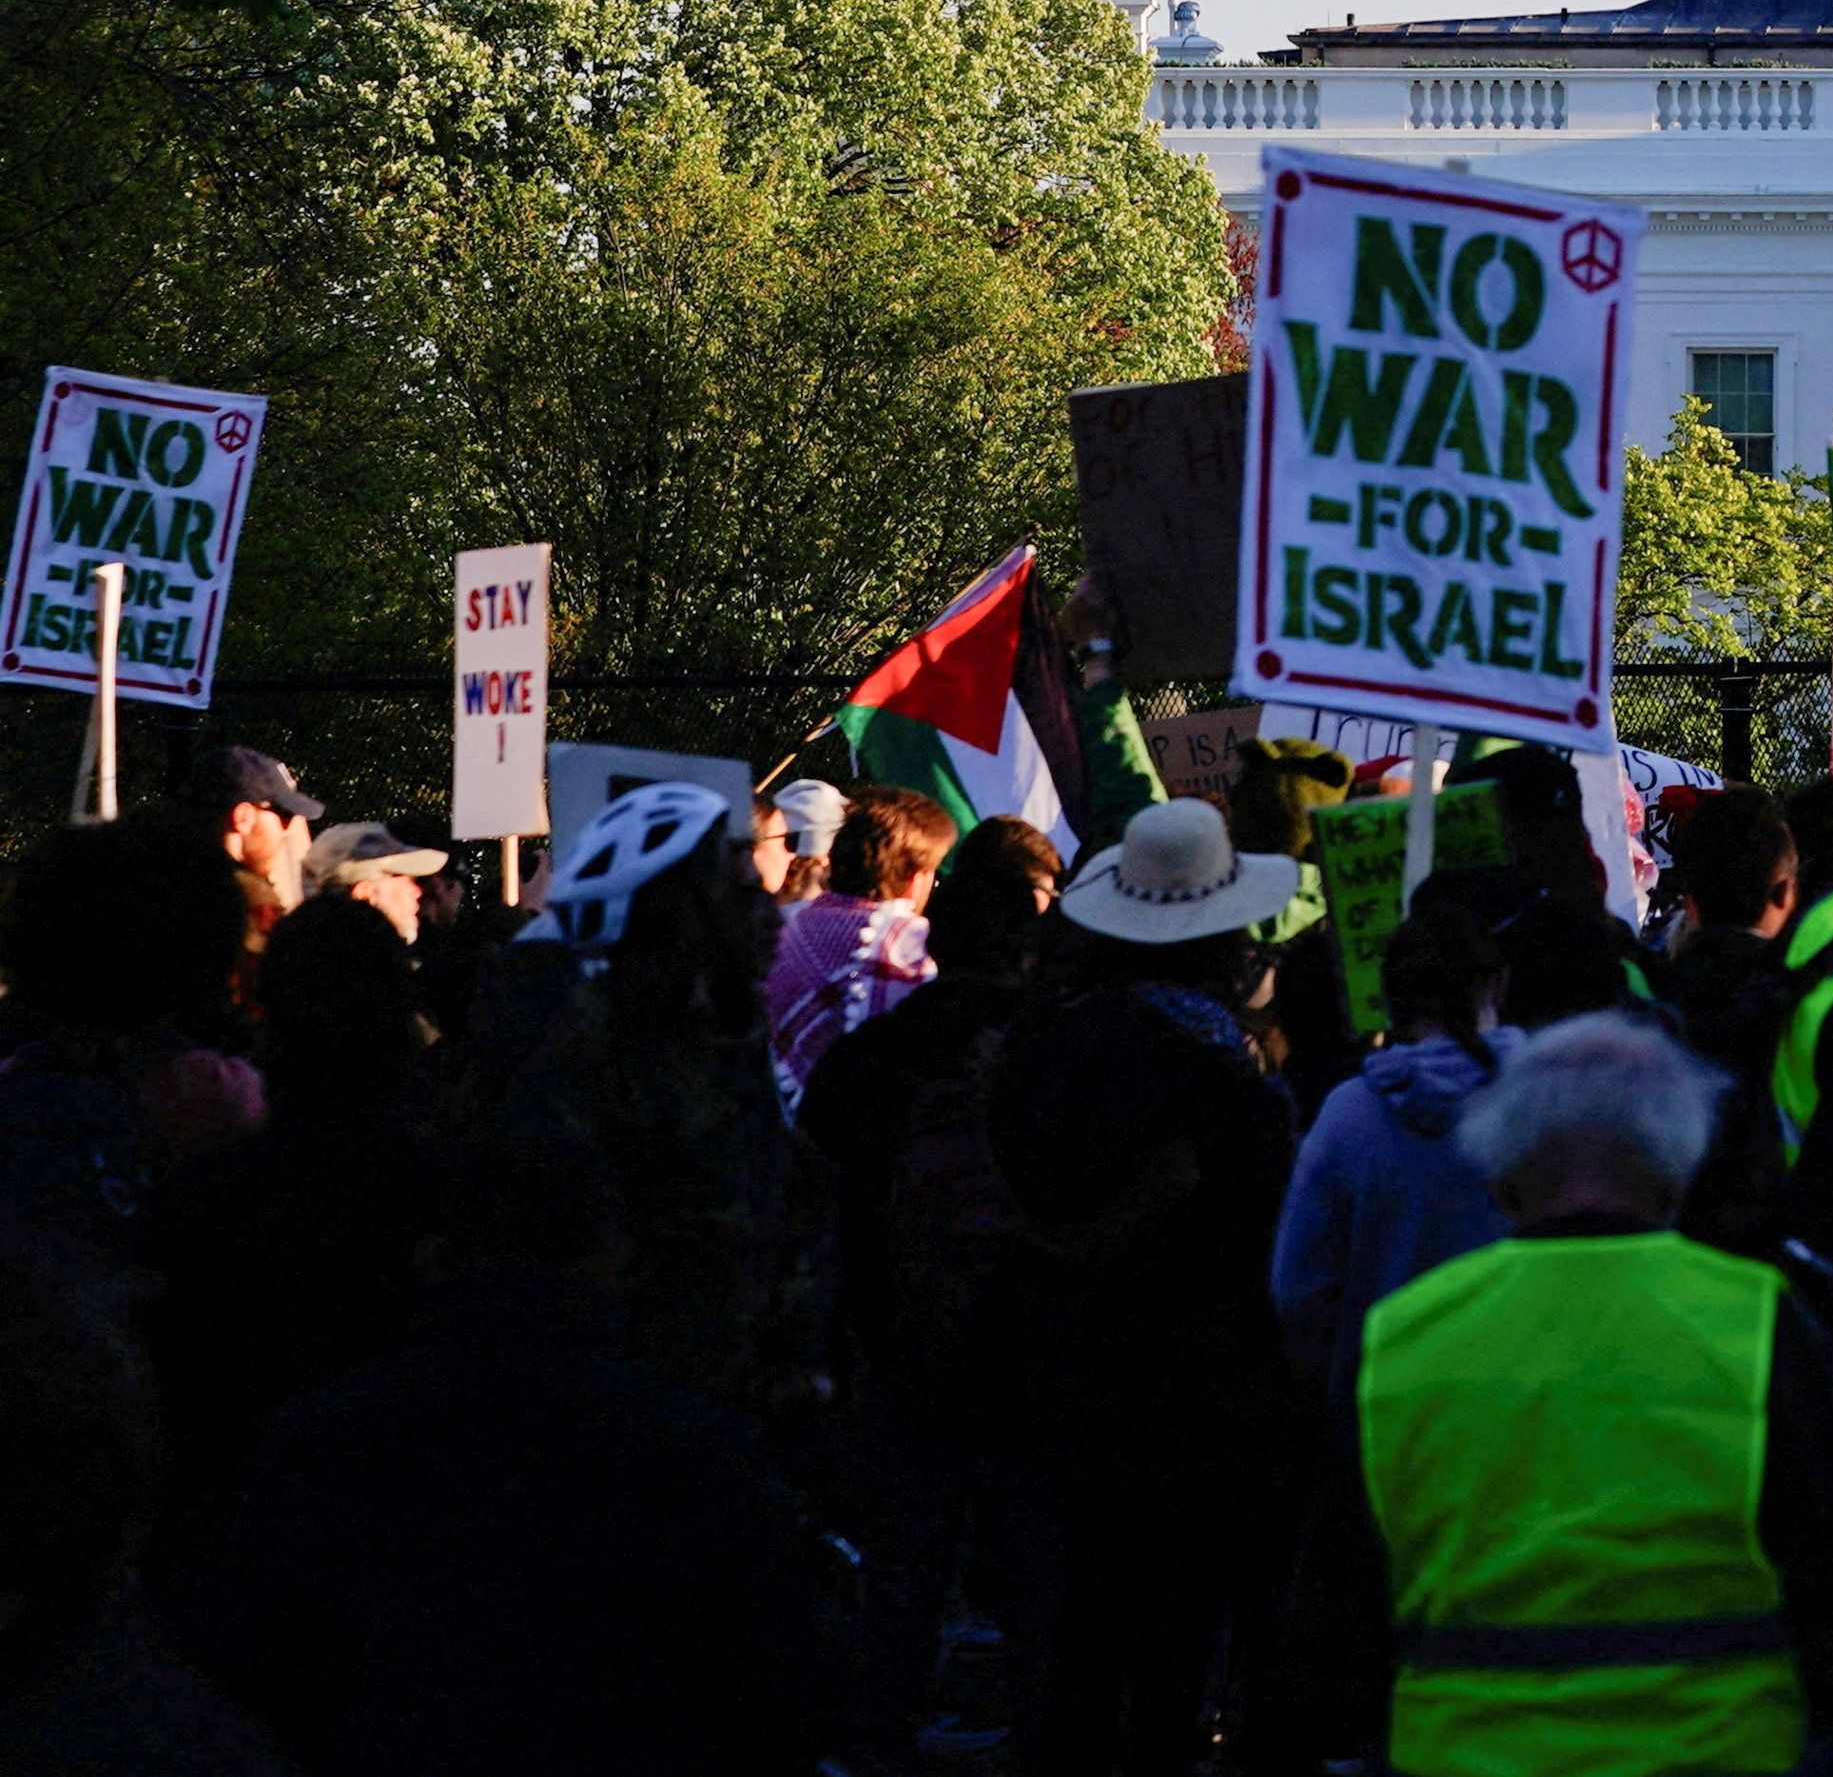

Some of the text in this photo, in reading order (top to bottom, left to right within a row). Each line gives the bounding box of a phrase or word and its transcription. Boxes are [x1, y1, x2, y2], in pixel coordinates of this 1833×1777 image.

[1350, 216, 1546, 352] NO
[87, 406, 204, 488] NO
[1283, 320, 1595, 518] WAR
[48, 466, 214, 580] WAR
[464, 579, 533, 634] STAY
[1281, 545, 1584, 681] ISRAEL
[461, 668, 533, 716] WOKE
[495, 722, 507, 764] !
[1186, 734, 1218, 769] IS
